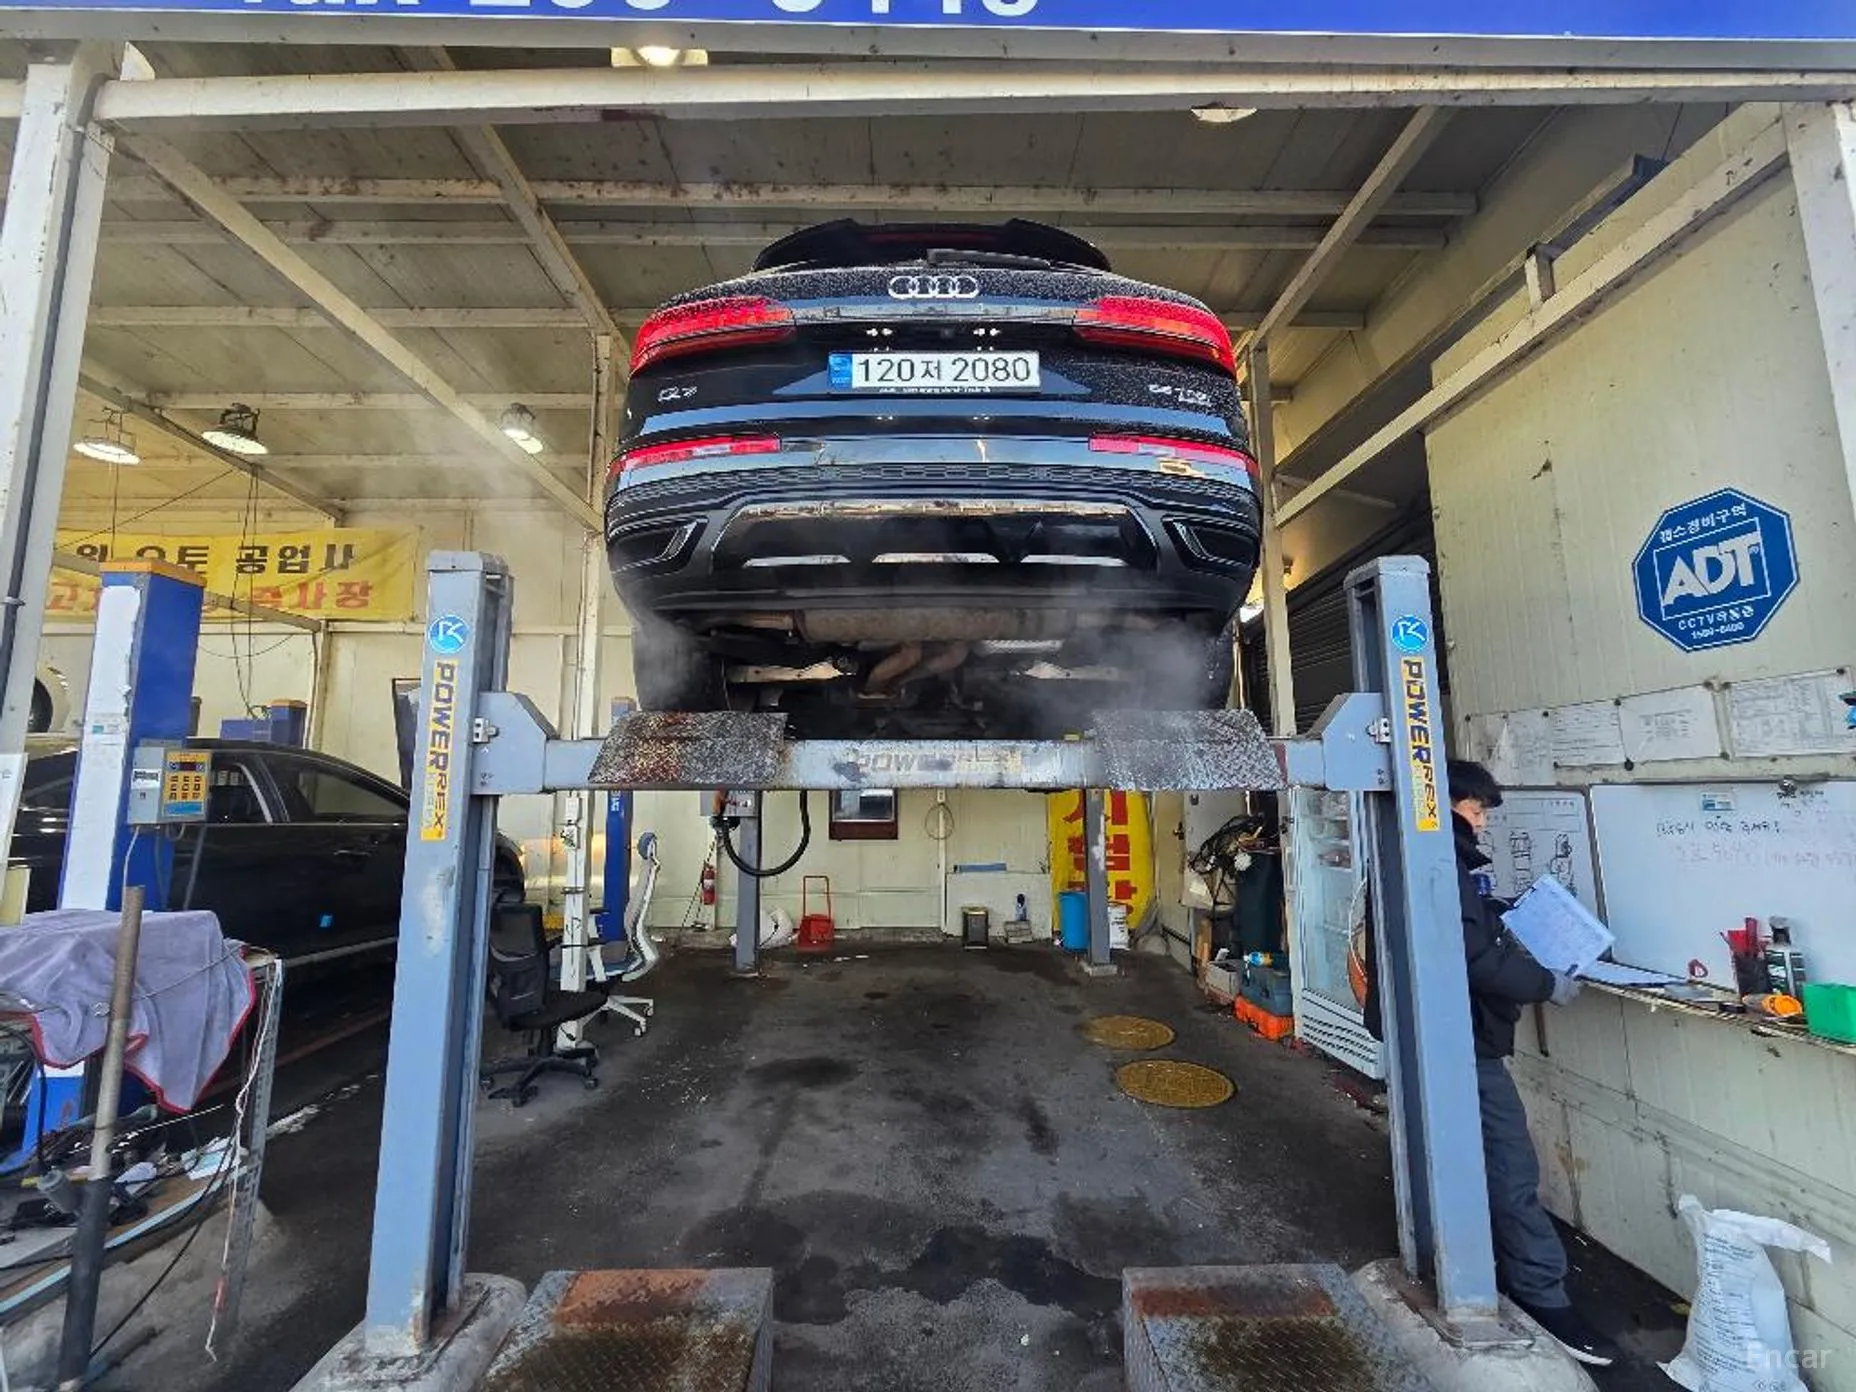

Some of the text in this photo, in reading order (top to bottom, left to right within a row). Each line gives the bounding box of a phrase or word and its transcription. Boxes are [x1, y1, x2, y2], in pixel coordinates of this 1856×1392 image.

[858, 357, 1031, 382] 120저 2080
[1662, 531, 1761, 607] ADT
